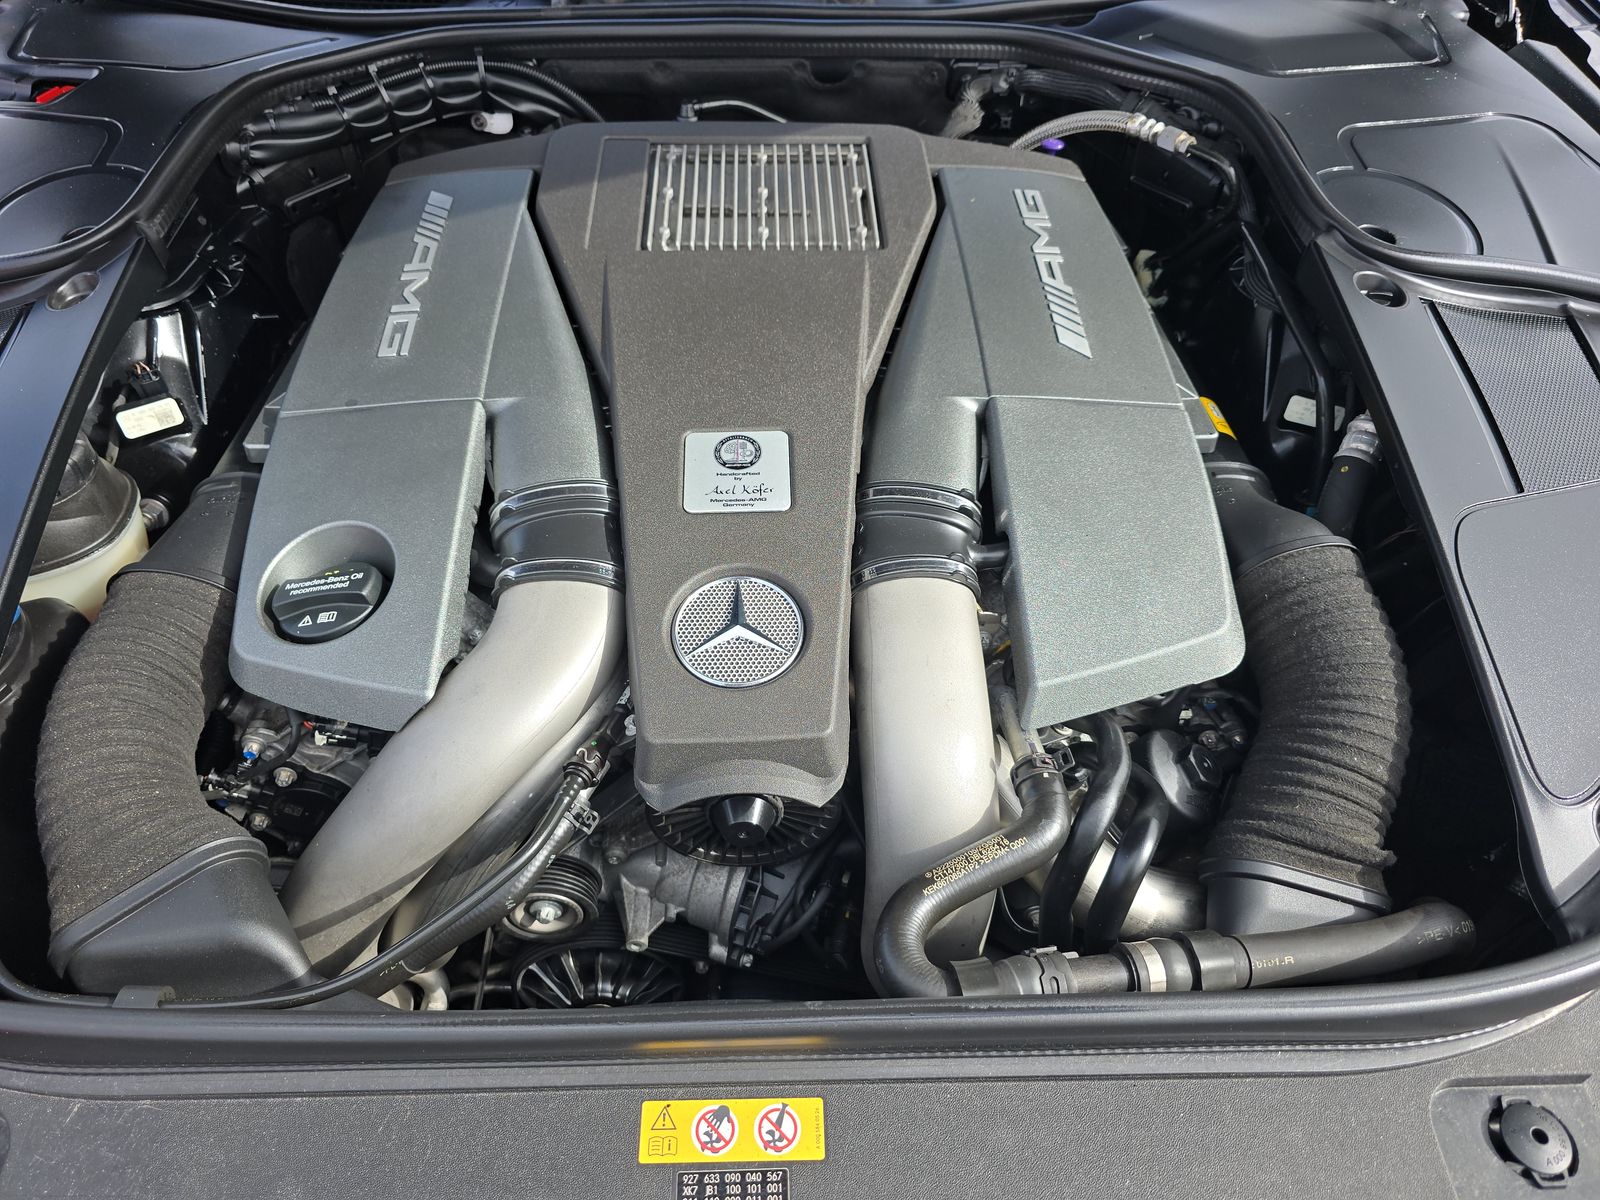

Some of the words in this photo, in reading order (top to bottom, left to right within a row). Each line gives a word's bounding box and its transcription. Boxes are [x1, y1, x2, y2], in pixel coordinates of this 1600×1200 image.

[1012, 188, 1074, 297] AMG
[377, 231, 440, 358] AMG
[285, 575, 350, 590] Mercedes-Benz
[350, 572, 364, 580] Oil
[289, 581, 350, 596] recommended
[682, 1174, 699, 1184] 927
[703, 1173, 720, 1184] 633
[724, 1173, 741, 1183] 090
[745, 1172, 762, 1182] 040
[766, 1171, 783, 1181] 567
[682, 1186, 698, 1196] XK7
[704, 1185, 718, 1196] JB1
[726, 1185, 741, 1194] 100
[747, 1184, 762, 1194] 101
[767, 1183, 783, 1193] 001
